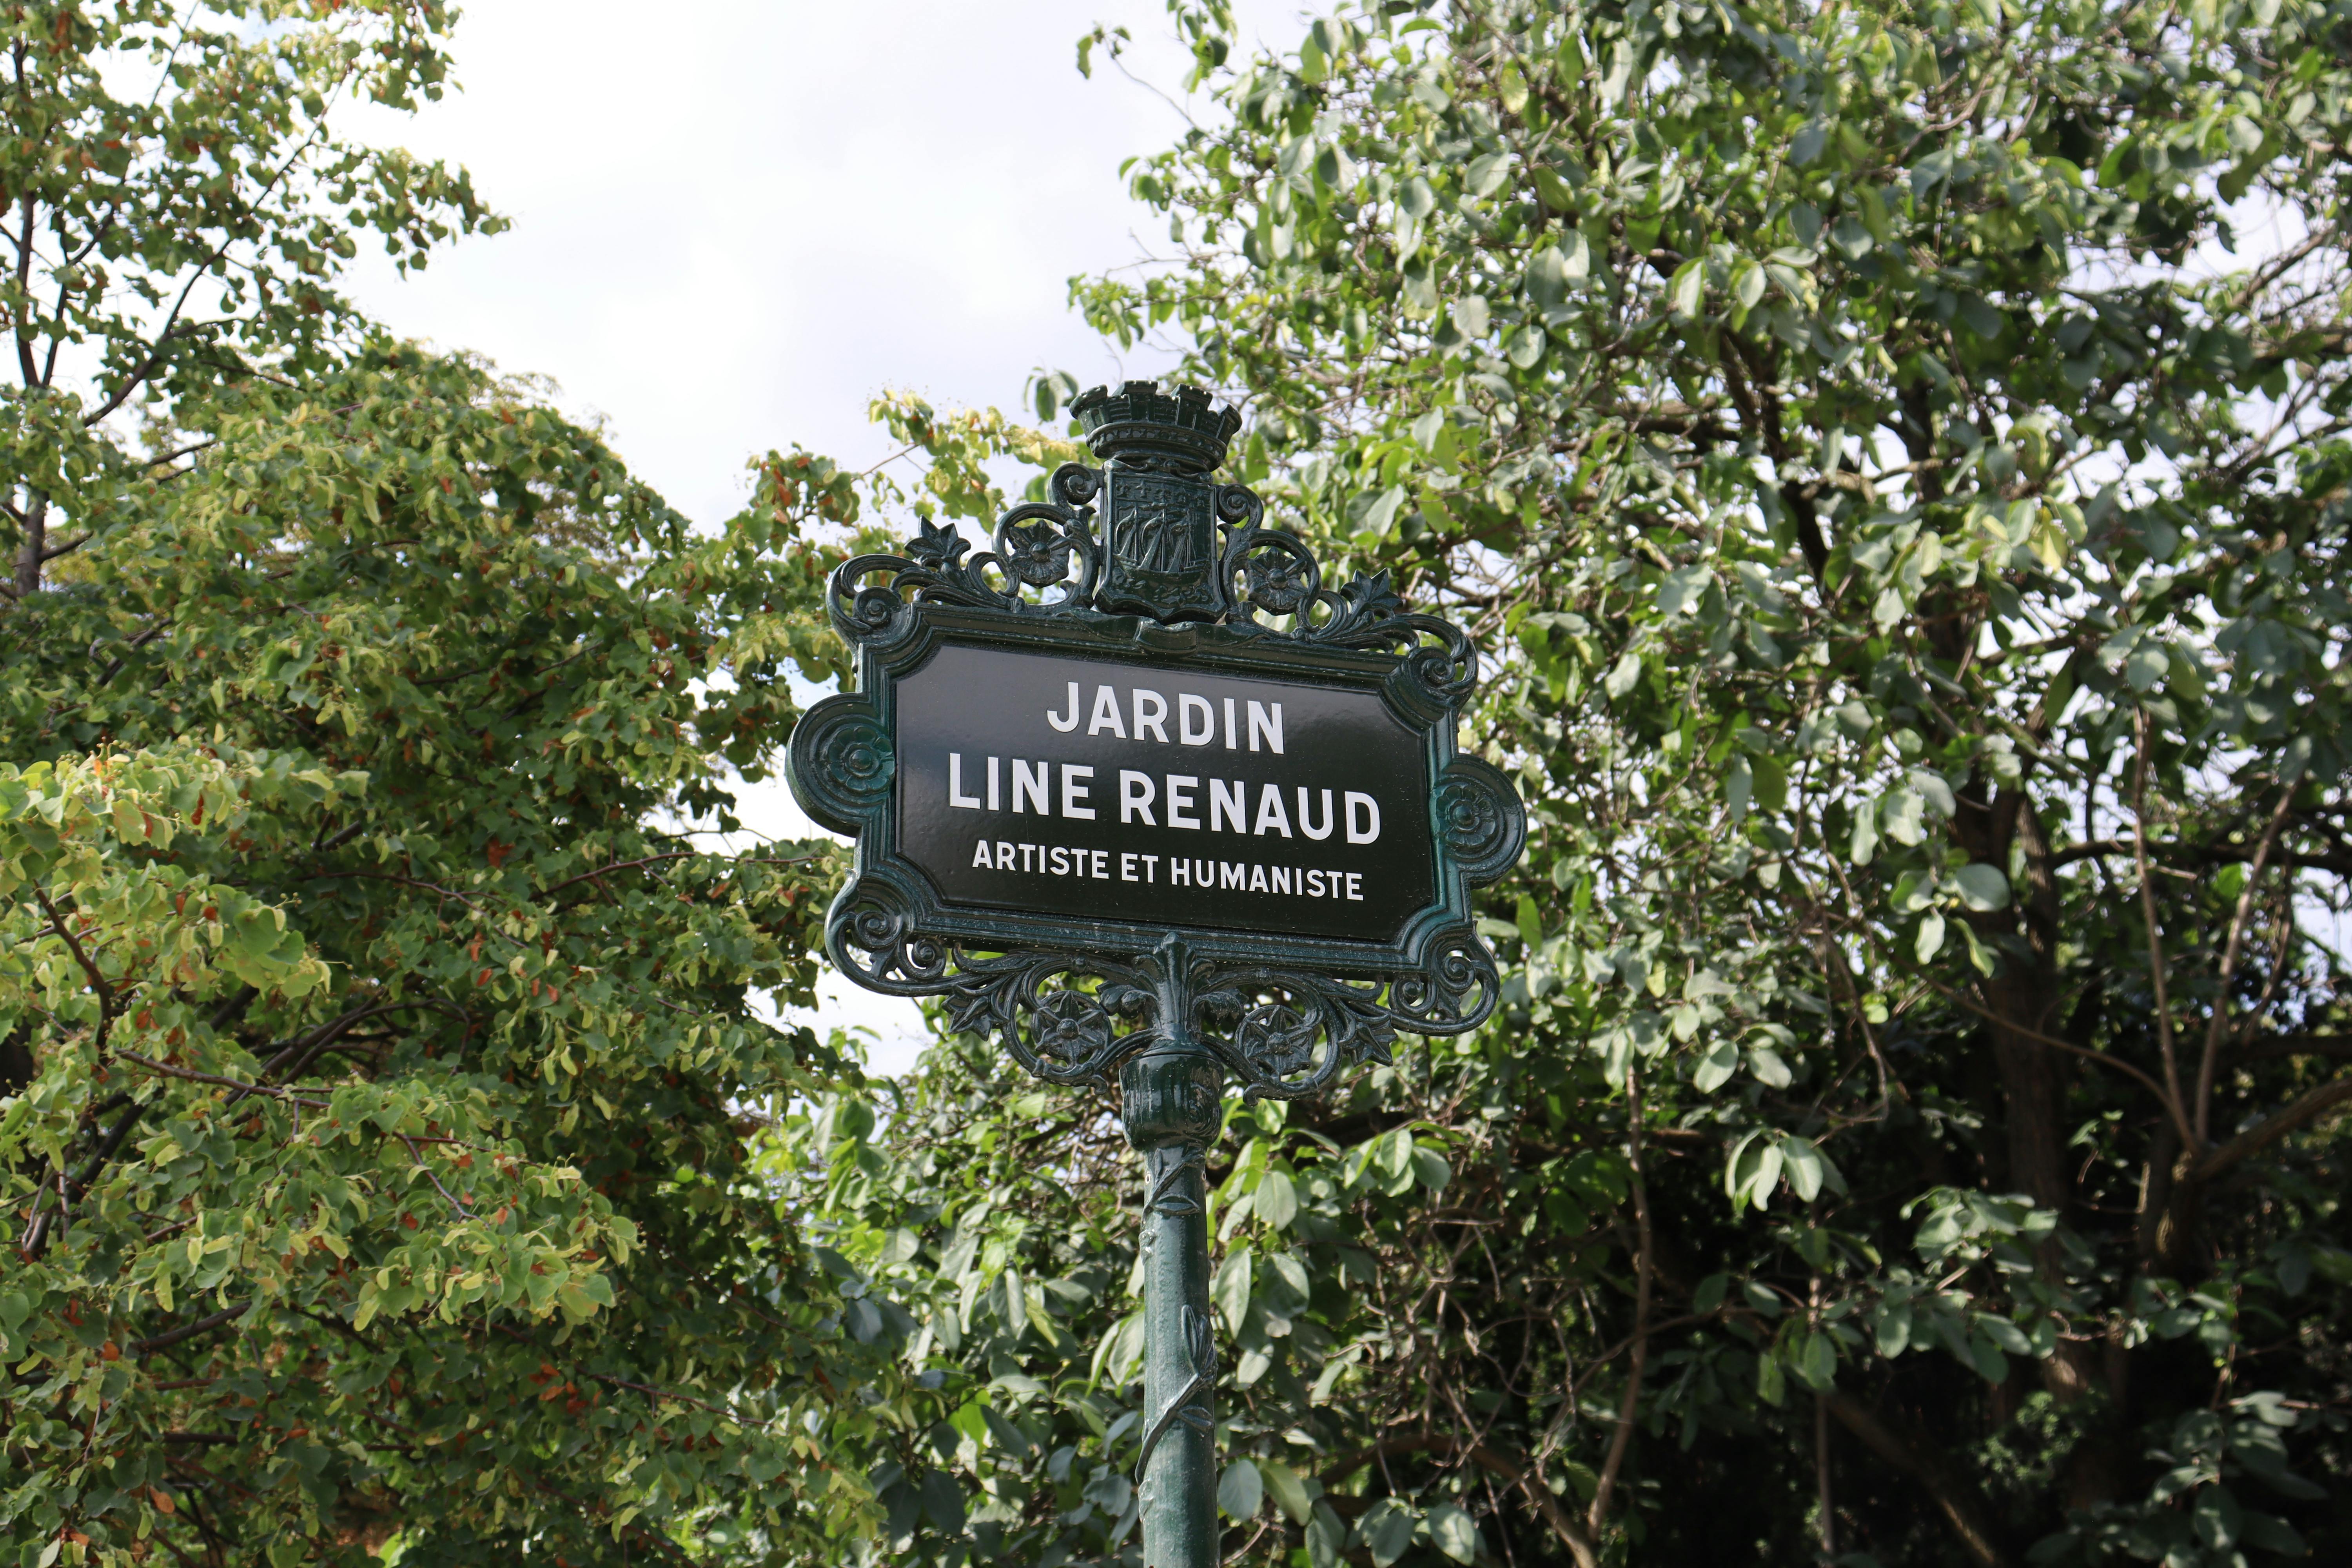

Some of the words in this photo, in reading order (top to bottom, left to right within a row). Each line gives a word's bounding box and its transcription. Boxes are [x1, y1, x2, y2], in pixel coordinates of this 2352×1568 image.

[1047, 681, 1285, 755] JARDIN
[949, 752, 1096, 821] LINE
[1119, 769, 1381, 845] RENAUD
[972, 840, 1109, 879] ARTISTE
[1121, 852, 1159, 883] ET
[1171, 857, 1364, 901] HUMANISTE
